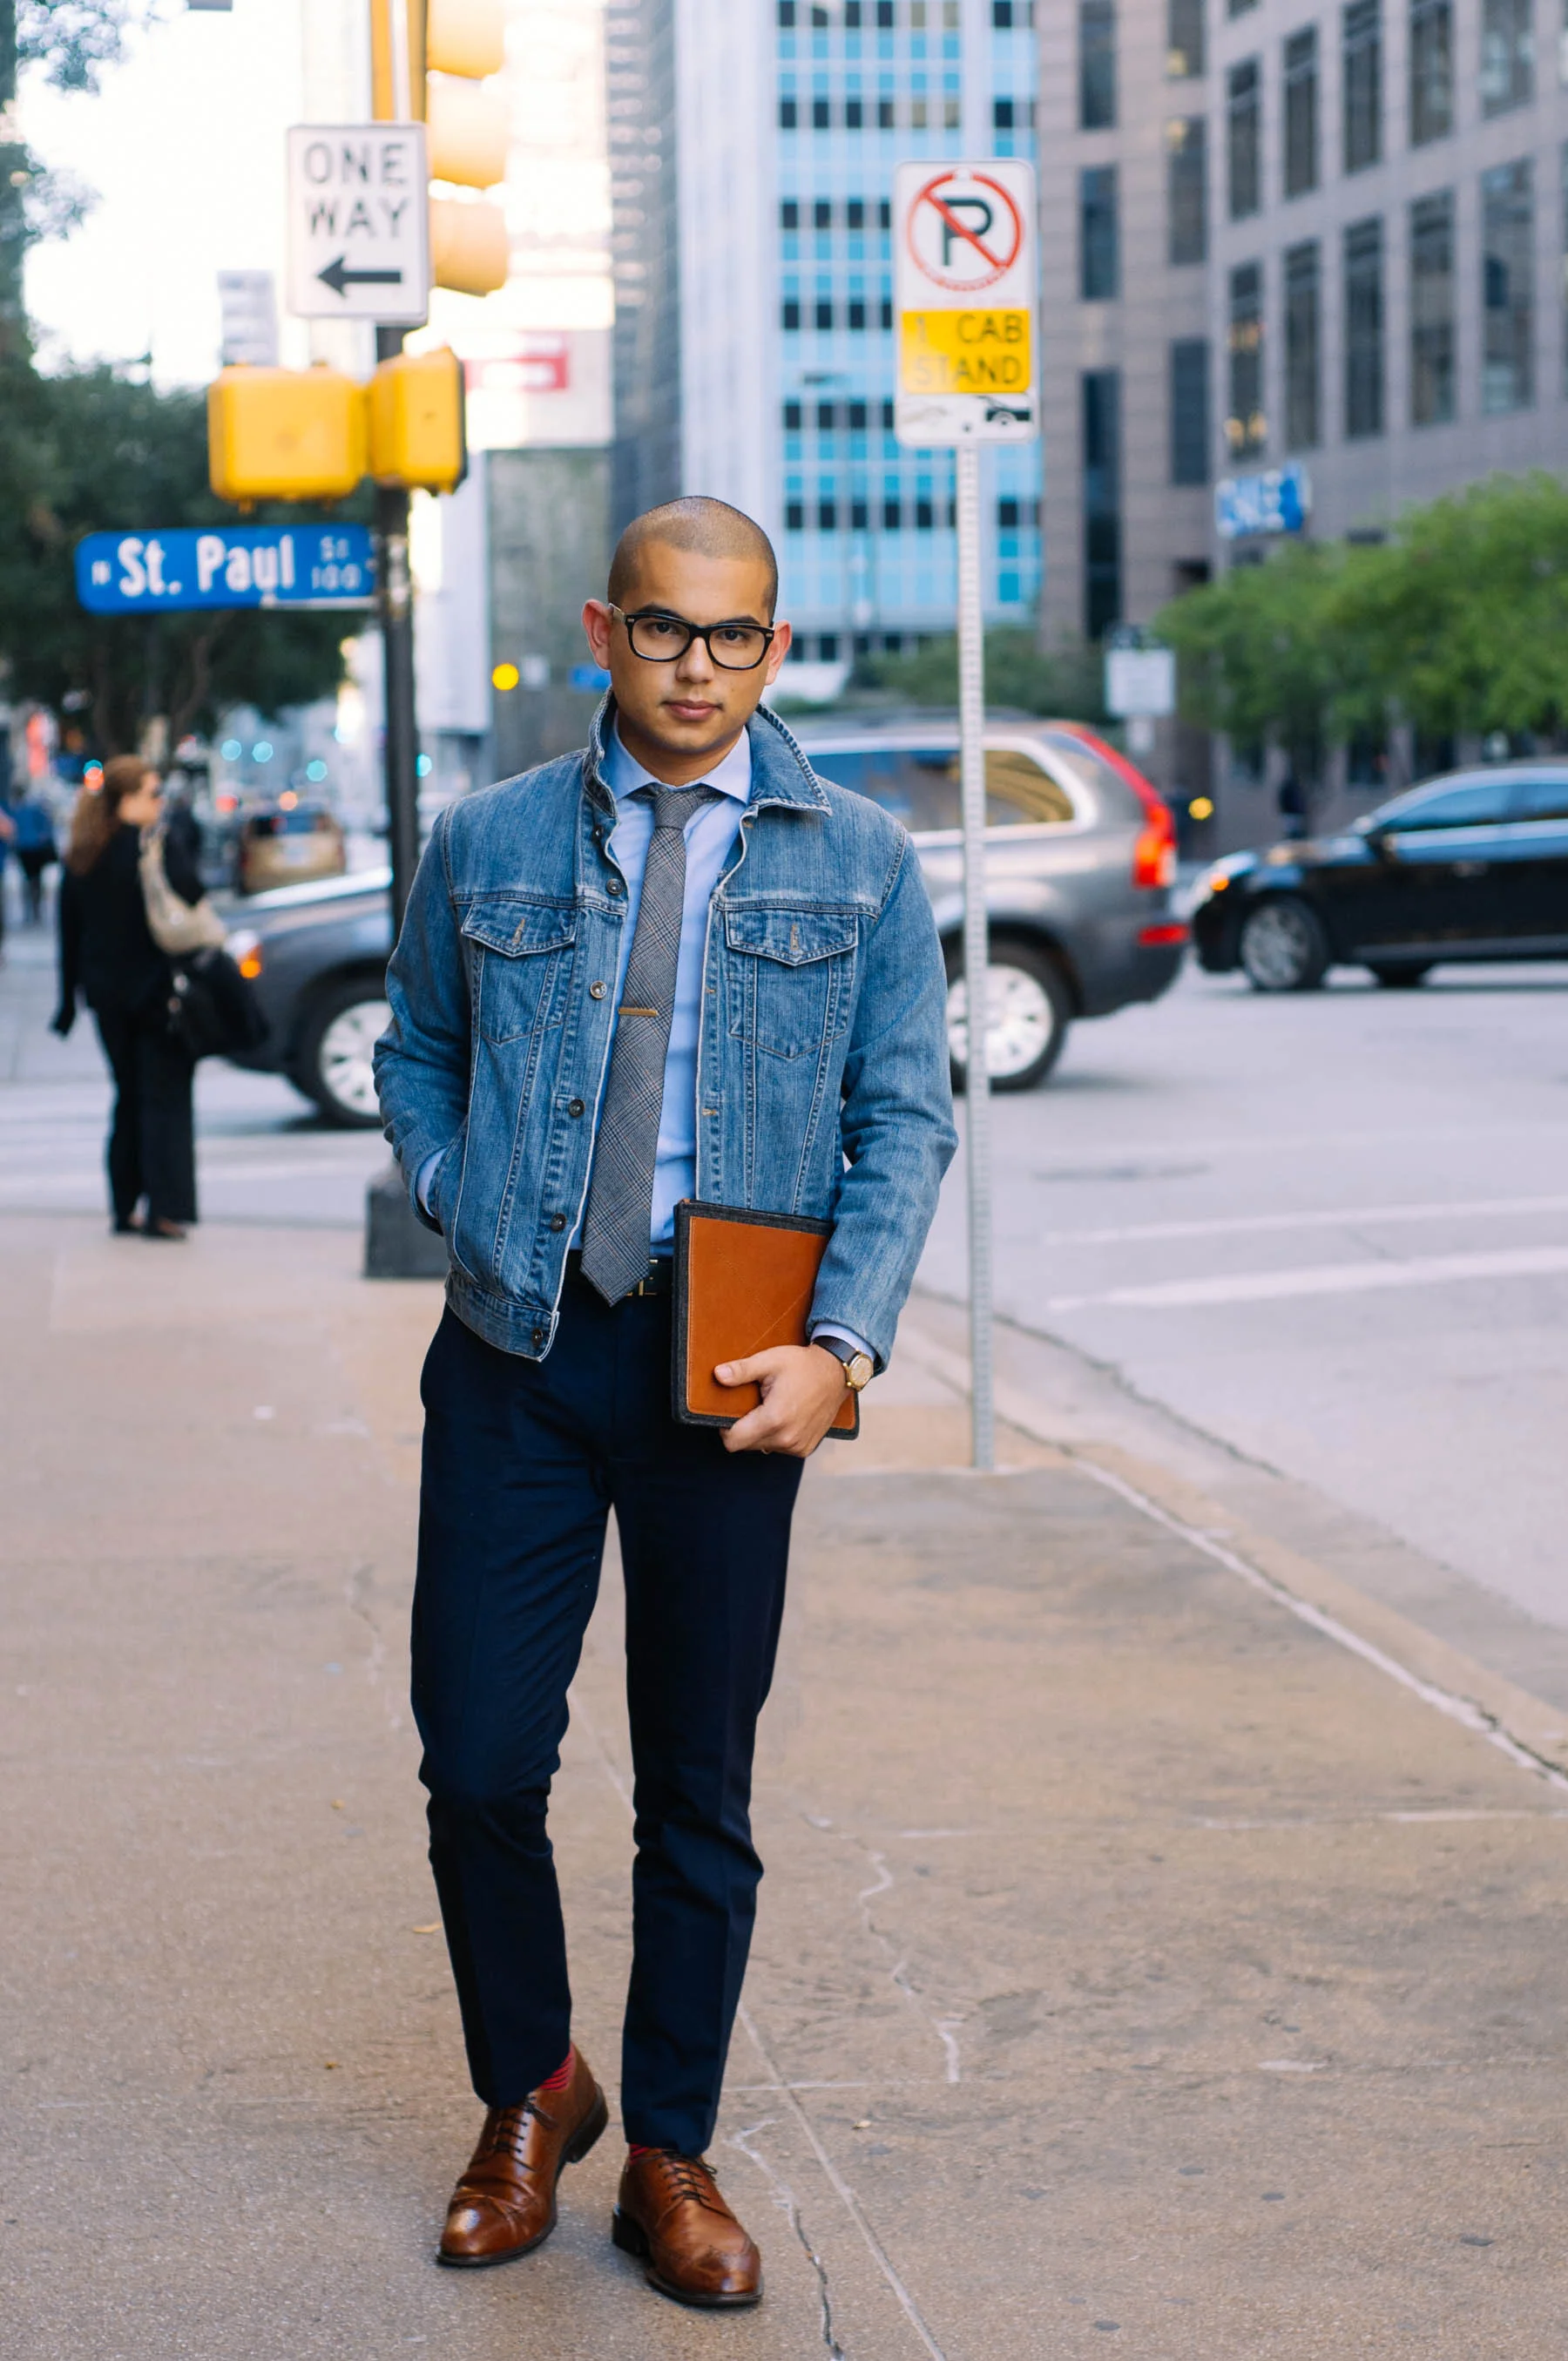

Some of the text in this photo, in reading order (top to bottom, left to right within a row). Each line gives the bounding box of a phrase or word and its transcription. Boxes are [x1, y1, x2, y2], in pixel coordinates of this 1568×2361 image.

[304, 142, 409, 184] ONE
[304, 195, 409, 239] WAY
[956, 313, 1023, 343] CAB
[915, 355, 1023, 385] STAND
[118, 537, 182, 598] St.
[196, 534, 294, 592] Paul
